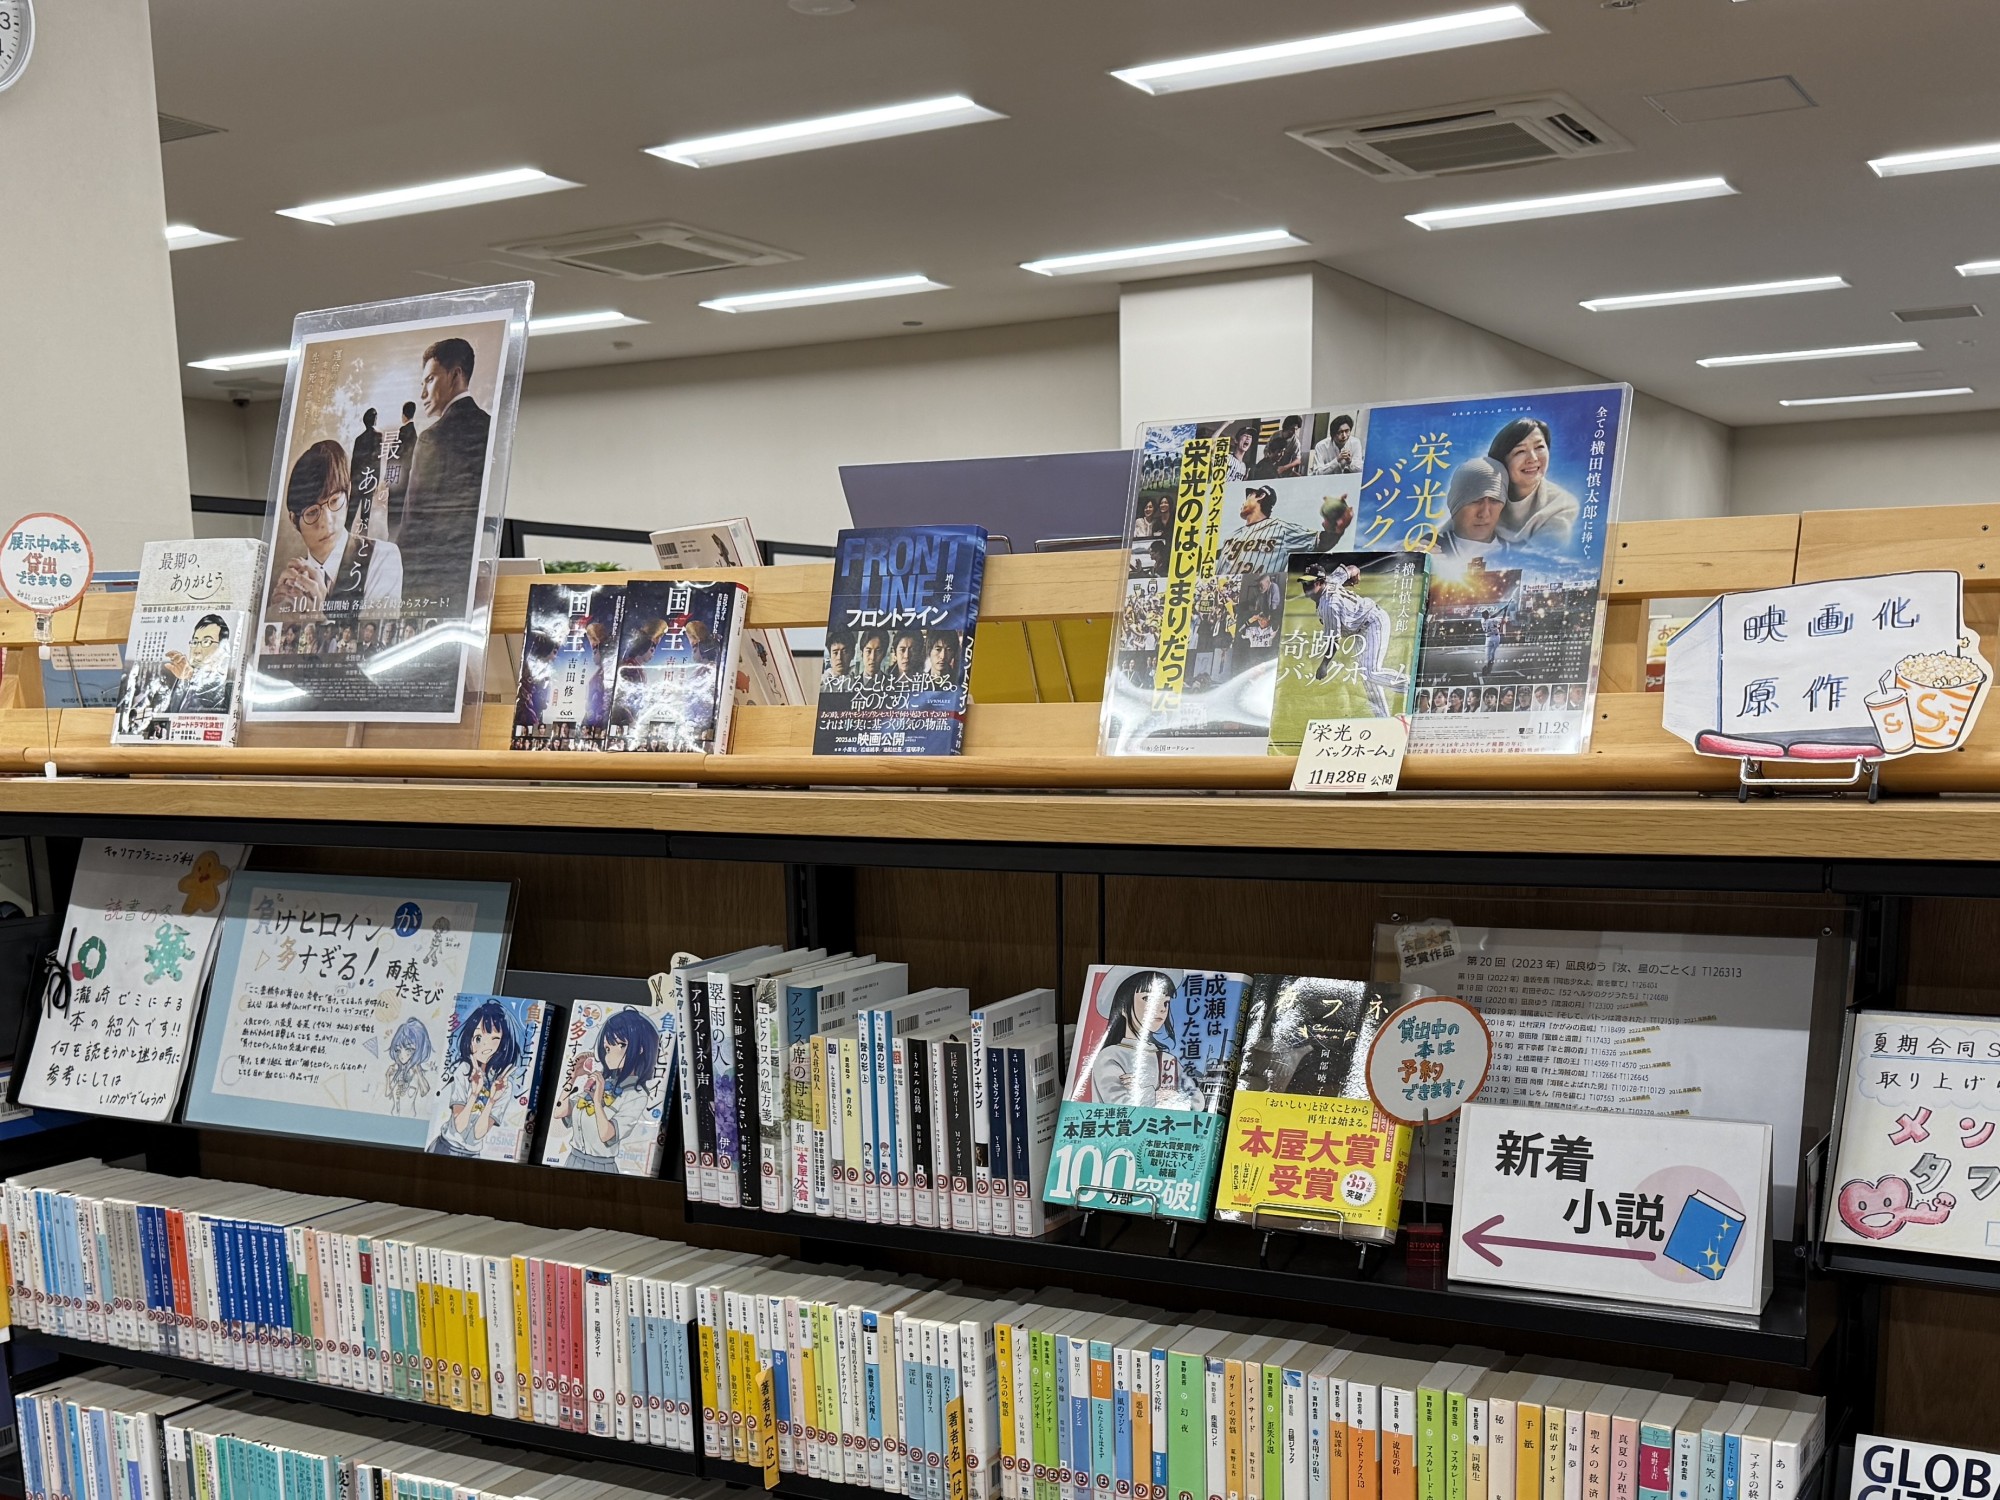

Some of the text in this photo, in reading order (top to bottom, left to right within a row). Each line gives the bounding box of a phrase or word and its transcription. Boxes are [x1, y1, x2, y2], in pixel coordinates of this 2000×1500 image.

[1200, 437, 1231, 578] 奇跡のバックホームは
[1403, 432, 1453, 552] 栄光の
[8, 532, 82, 553] 展示中の本も
[841, 535, 968, 577] FRONT
[23, 553, 59, 575] 貸出
[158, 552, 201, 571] 最期の、
[1153, 439, 1211, 710] 栄光のはじまりだった
[17, 573, 58, 588] できます
[170, 572, 226, 594] ありがとう。
[860, 575, 937, 612] LINE
[1395, 562, 1416, 633] 横田慎太郎
[661, 587, 692, 651] 国宝
[846, 607, 949, 628] フロントライン
[1743, 596, 1921, 644] 映画化
[1282, 630, 1367, 661] 奇跡の
[824, 672, 958, 693] やれることは全部やる。
[959, 636, 975, 716] フロントライン
[851, 692, 920, 712] 命のために
[1736, 673, 1850, 718] 原作
[820, 718, 952, 732] これは事実に基づく勇気の物語。
[857, 732, 906, 747] 映画公開
[1538, 721, 1570, 734] 11.28
[1316, 742, 1396, 760] バックホーム』
[1307, 769, 1393, 786] 11月28日 公開
[277, 934, 381, 986] 多すぎる!
[386, 957, 420, 982] 雨森
[1403, 944, 1456, 970] 受賞作品
[1702, 966, 1743, 978] T126313
[395, 979, 445, 1006] たきび
[1203, 974, 1228, 1036] 成瀬は
[691, 989, 710, 1088] アリアドネの声
[708, 982, 730, 1067] 翠雨の人
[1397, 1014, 1461, 1044] 貸出中の
[50, 1040, 182, 1065] 何を読もうかと迷う時に
[733, 990, 748, 1130] 二人一組になってください
[791, 991, 808, 1097] アルプス席の母
[1414, 1041, 1456, 1059] 本は
[46, 1064, 122, 1087] 参考にしては
[757, 1006, 773, 1123] エピクロスの処方箋
[812, 1042, 821, 1091] 屍人荘の殺人
[913, 1052, 922, 1114] ミカエルの鼓動
[973, 1038, 983, 1109] ライオン・キング
[1397, 1059, 1446, 1084] 予約
[99, 1090, 168, 1107] いかがでしょうか
[1265, 1098, 1369, 1116] 「おいしい」と泣くことから
[1401, 1078, 1466, 1103] できます!
[1062, 1114, 1213, 1139] 本屋大賞ノミネート!
[1086, 1106, 1129, 1120] 2年連続
[1307, 1114, 1368, 1129] 再生は始まる。
[1145, 1139, 1200, 1152] 本屋大賞受賞作
[1239, 1125, 1380, 1169] 本屋大賞
[1495, 1129, 1594, 1183] 新着
[796, 1152, 809, 1202] 本屋大賞
[1049, 1144, 1137, 1204] 100
[1132, 1174, 1201, 1212] 突破!
[1158, 1167, 1177, 1179] 続編
[1267, 1164, 1339, 1203] 受賞
[1346, 1173, 1366, 1191] 35
[1563, 1189, 1667, 1243] 小説
[1015, 1338, 1024, 1404] イノセント・デイズ
[761, 1380, 773, 1429] 著者名
[1117, 1397, 1125, 1434] 風のマジム
[1180, 1407, 1189, 1433] 幻夜
[1228, 1374, 1237, 1435] ガリレオの苦悩
[1248, 1377, 1256, 1433] レイクサイド
[948, 1410, 961, 1463] 著者名
[1523, 1420, 1534, 1449] 手紙
[1549, 1422, 1559, 1483] 探偵ガリレオ
[1356, 1436, 1365, 1489] パラドックス13
[1472, 1453, 1481, 1482] 同級生
[1588, 1429, 1600, 1499] 聖女の救済
[1863, 1445, 2000, 1500] GLOB
